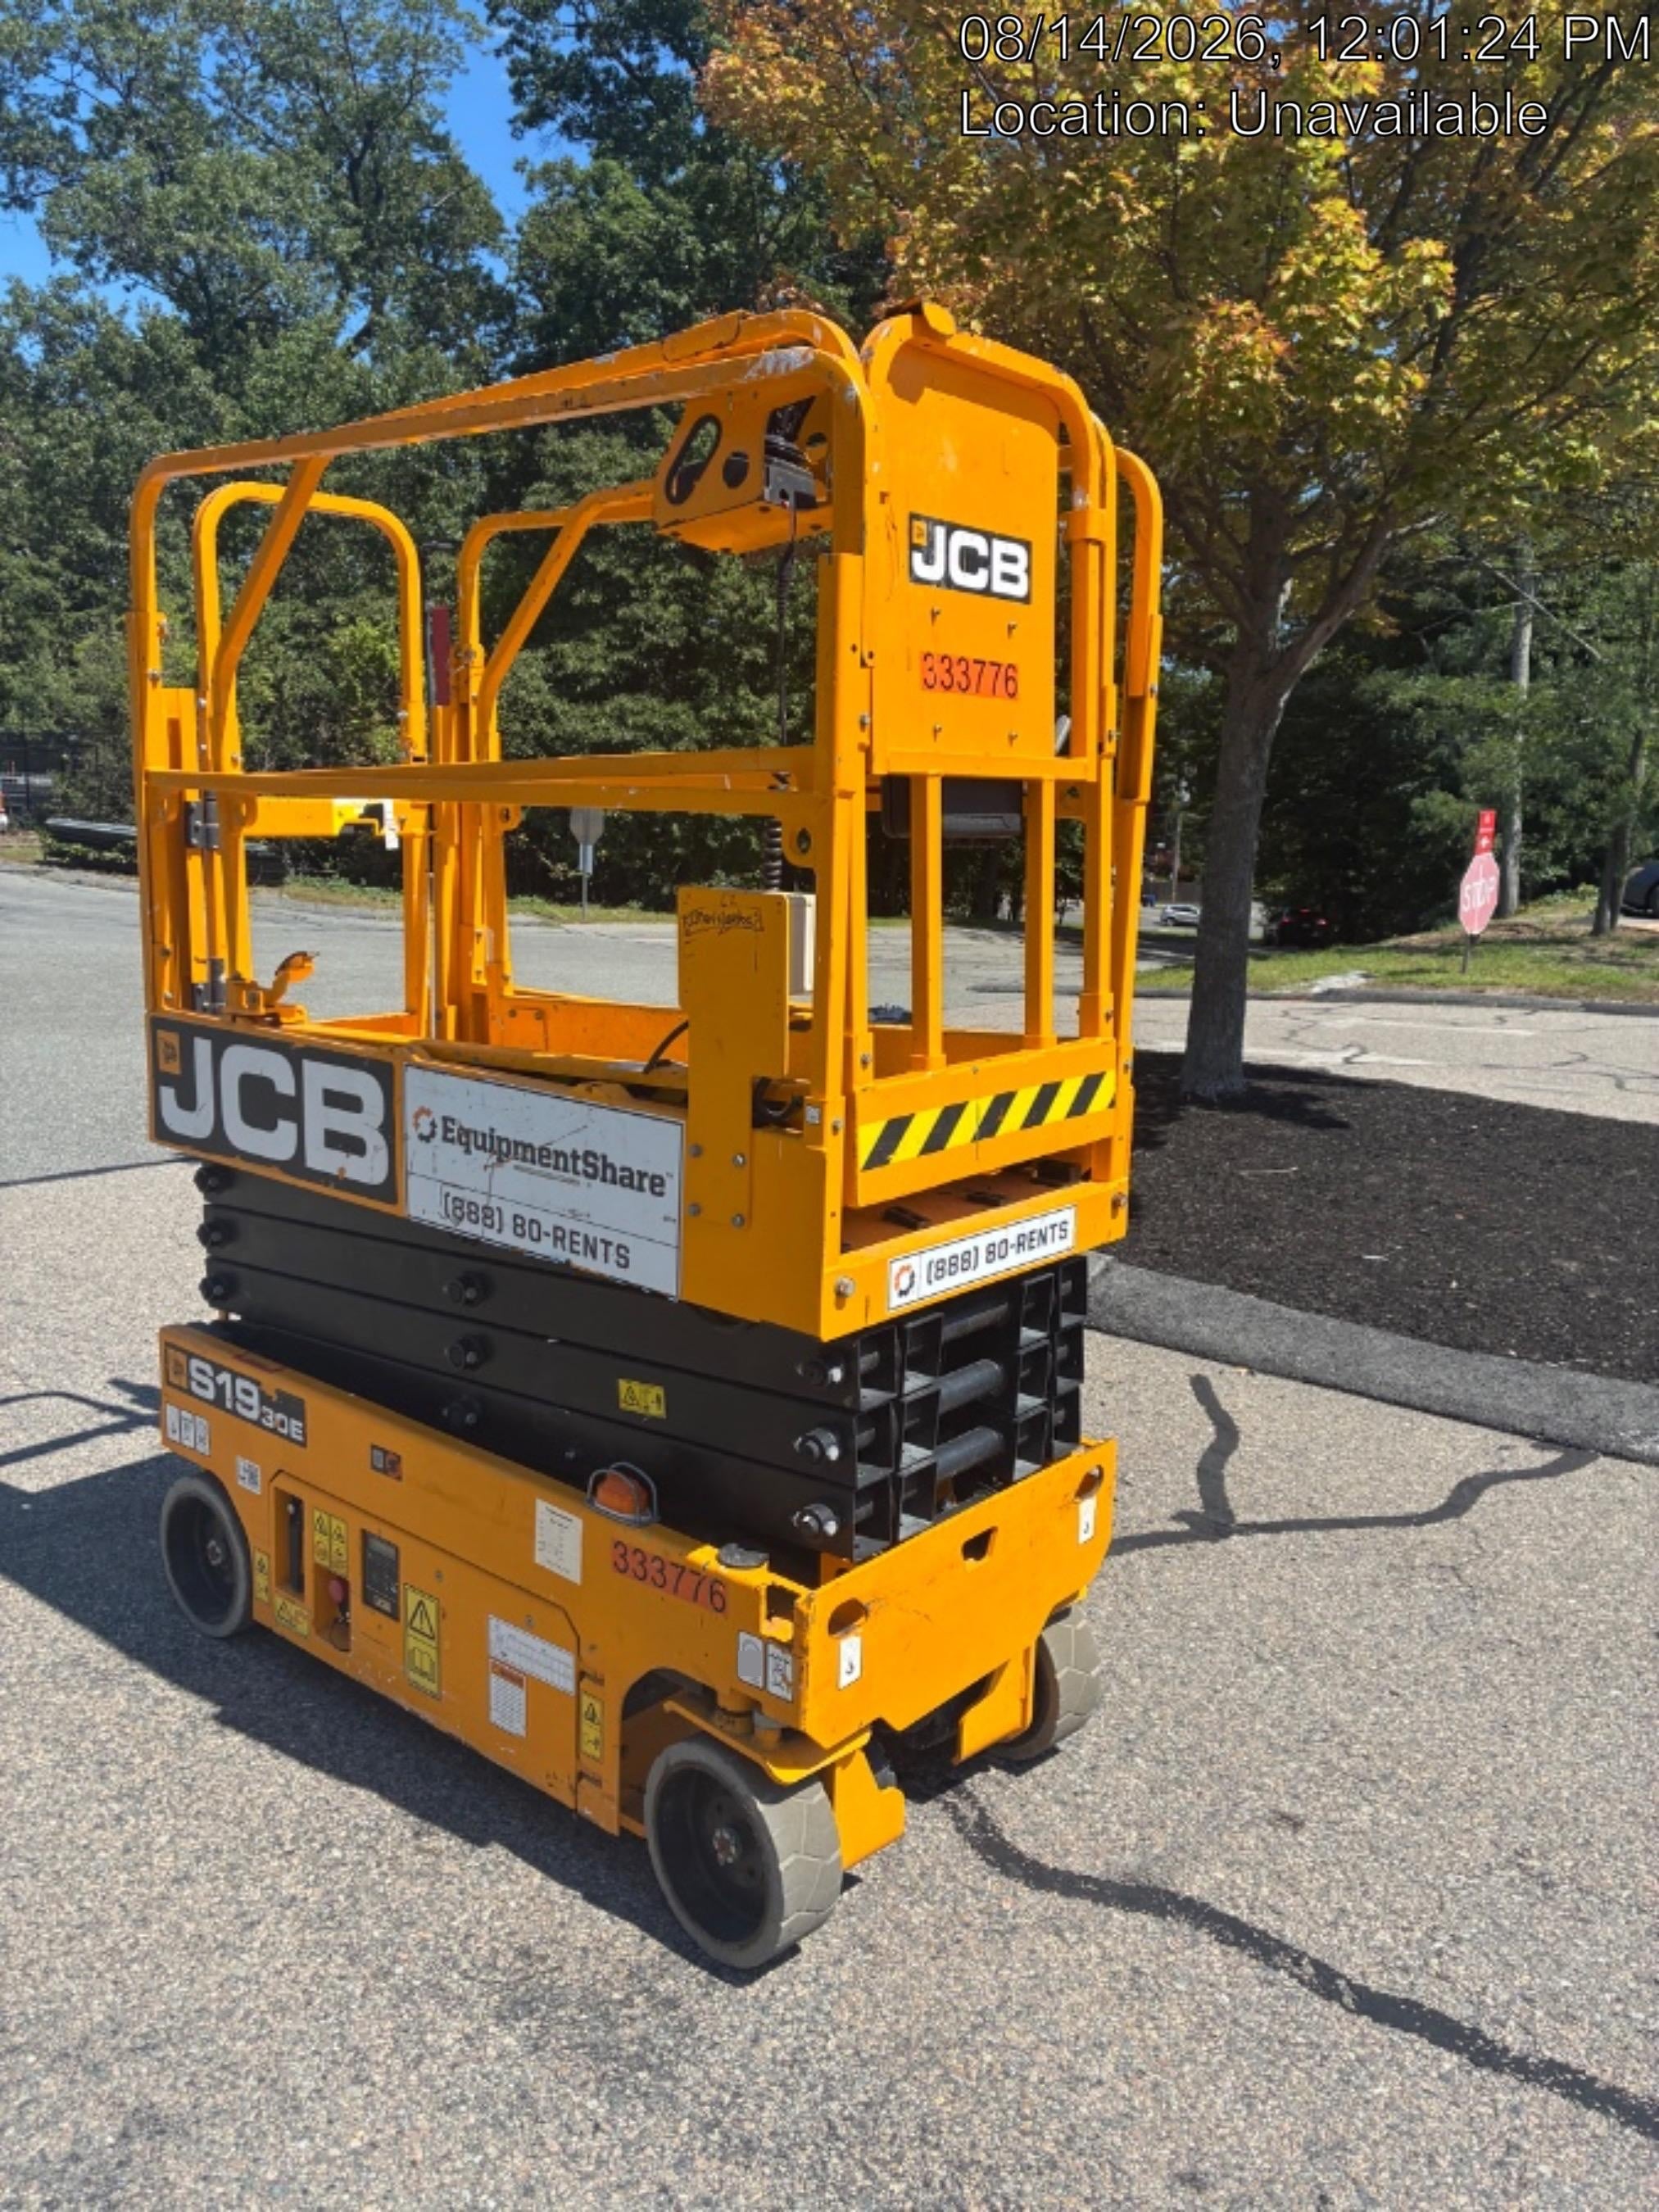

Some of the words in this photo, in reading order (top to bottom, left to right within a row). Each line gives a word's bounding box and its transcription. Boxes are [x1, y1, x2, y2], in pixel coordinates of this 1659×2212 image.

[912, 525, 1028, 598] JCB
[923, 652, 1018, 698] 333776
[1462, 877, 1496, 913] STOP
[159, 1036, 389, 1185] JCB
[442, 1115, 666, 1198] EquipmentShare
[443, 1192, 504, 1233] (888)
[513, 1213, 631, 1269] 80-RENTS
[927, 1246, 980, 1286] (888)
[985, 1220, 1068, 1264] 80-RENTS
[614, 1540, 727, 1613] 333776
